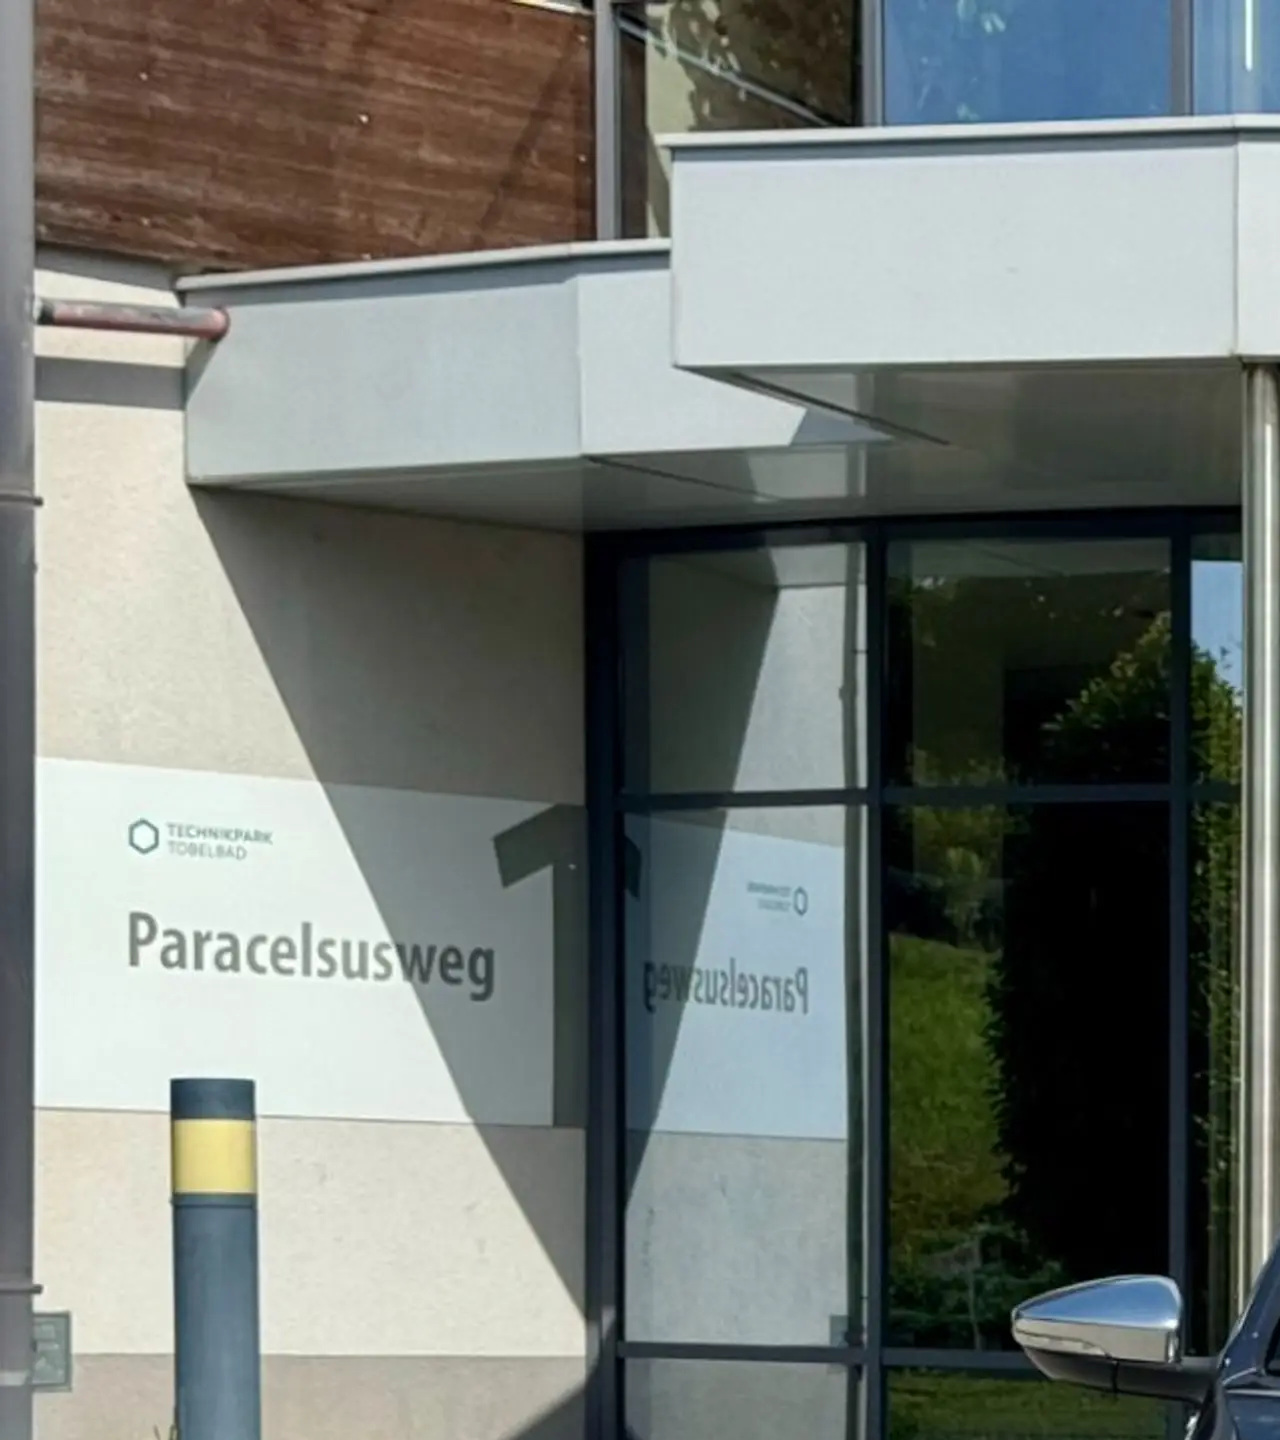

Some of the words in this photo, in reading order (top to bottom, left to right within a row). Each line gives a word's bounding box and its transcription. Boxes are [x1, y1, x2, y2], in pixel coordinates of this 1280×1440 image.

[166, 821, 273, 845] TECHNIKPARK
[167, 840, 247, 861] TOBELBAD
[128, 910, 495, 1002] Paracelsusweg
